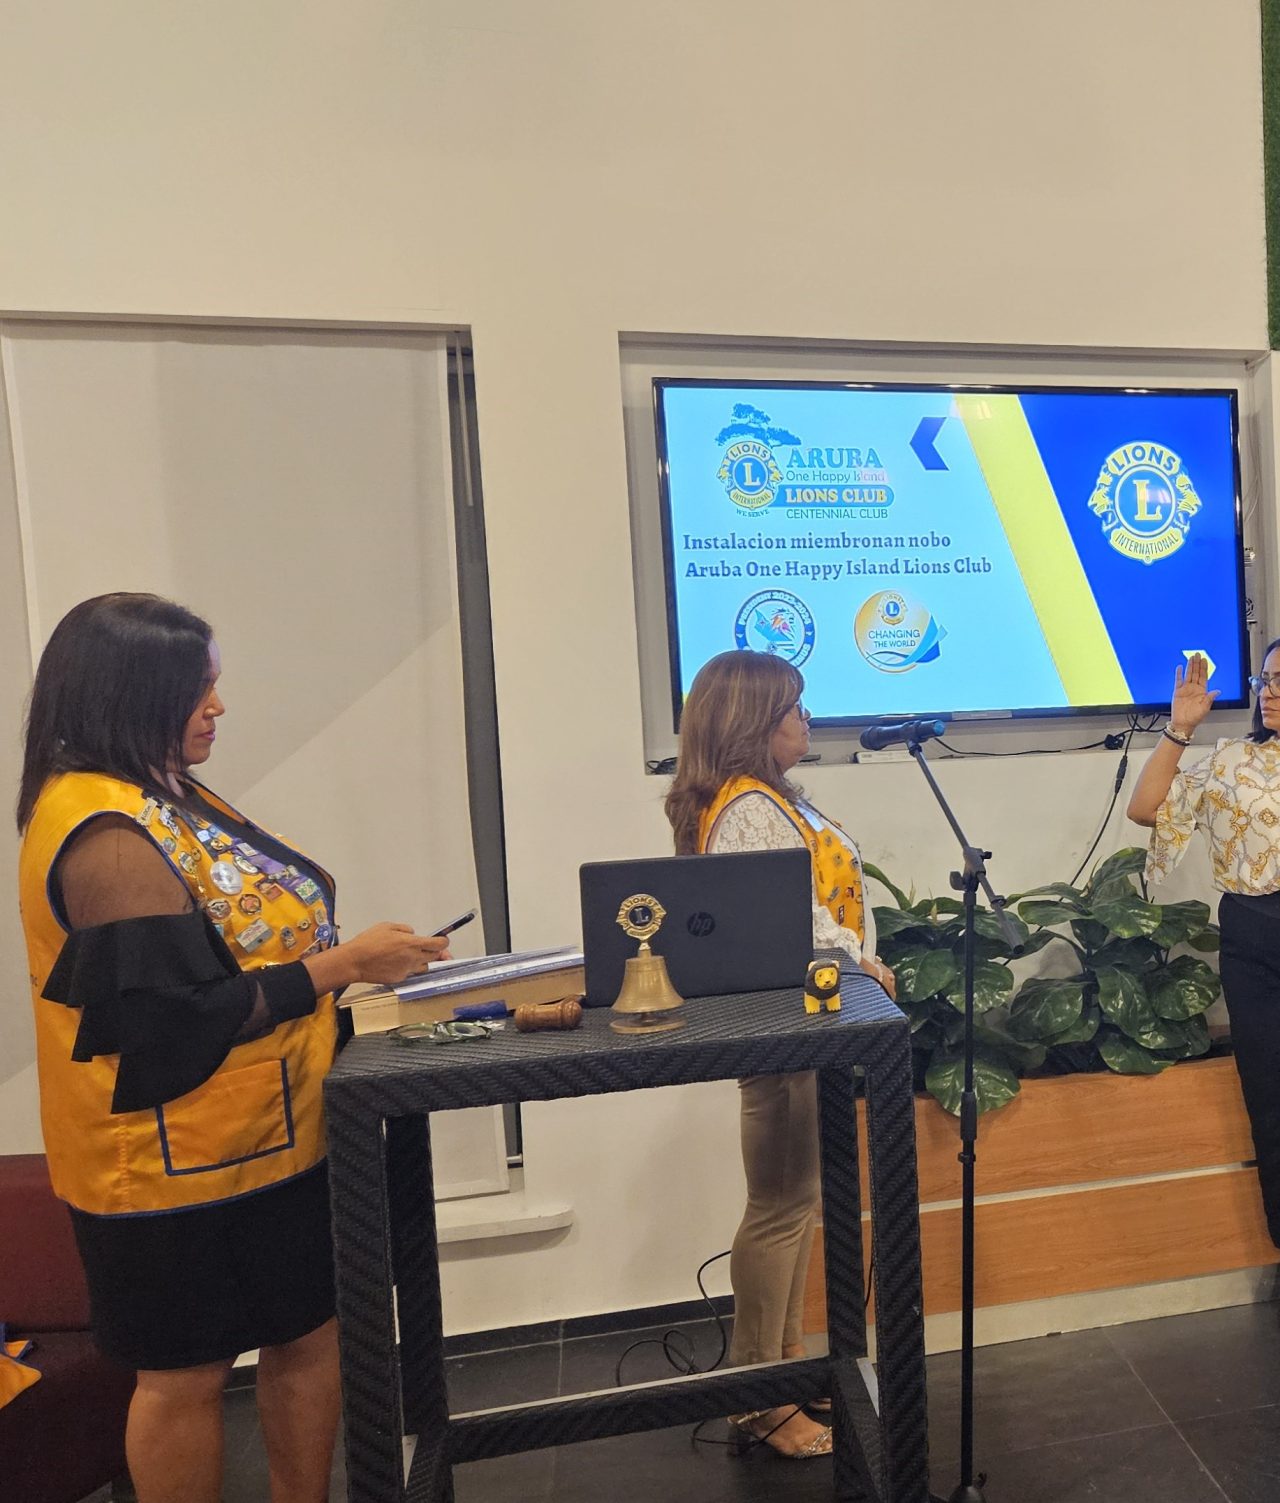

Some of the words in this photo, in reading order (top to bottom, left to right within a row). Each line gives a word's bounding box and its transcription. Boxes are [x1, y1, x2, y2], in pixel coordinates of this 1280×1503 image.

[730, 444, 768, 459] LIONS
[786, 447, 883, 469] ARUBA
[1111, 445, 1176, 471] LIONS
[743, 462, 760, 486] L
[786, 471, 809, 482] One
[813, 470, 850, 484] Happy
[854, 471, 885, 482] Island
[785, 488, 838, 503] LIONS
[842, 488, 887, 503] CLUB
[1132, 479, 1163, 521] L
[786, 509, 856, 519] CENTENNIAL
[859, 509, 888, 519] CLUB
[683, 533, 785, 550] Instalacion
[790, 532, 907, 549] miembronan
[908, 531, 951, 548] nobo
[1114, 532, 1179, 555] INTERNATIONAL
[685, 560, 742, 578] Aruba
[746, 561, 781, 577] One
[785, 560, 843, 581] Happy
[846, 558, 900, 576] Island
[903, 558, 951, 575] Lions
[954, 556, 992, 574] Club
[868, 629, 920, 639] CHANGING
[874, 640, 888, 648] THE
